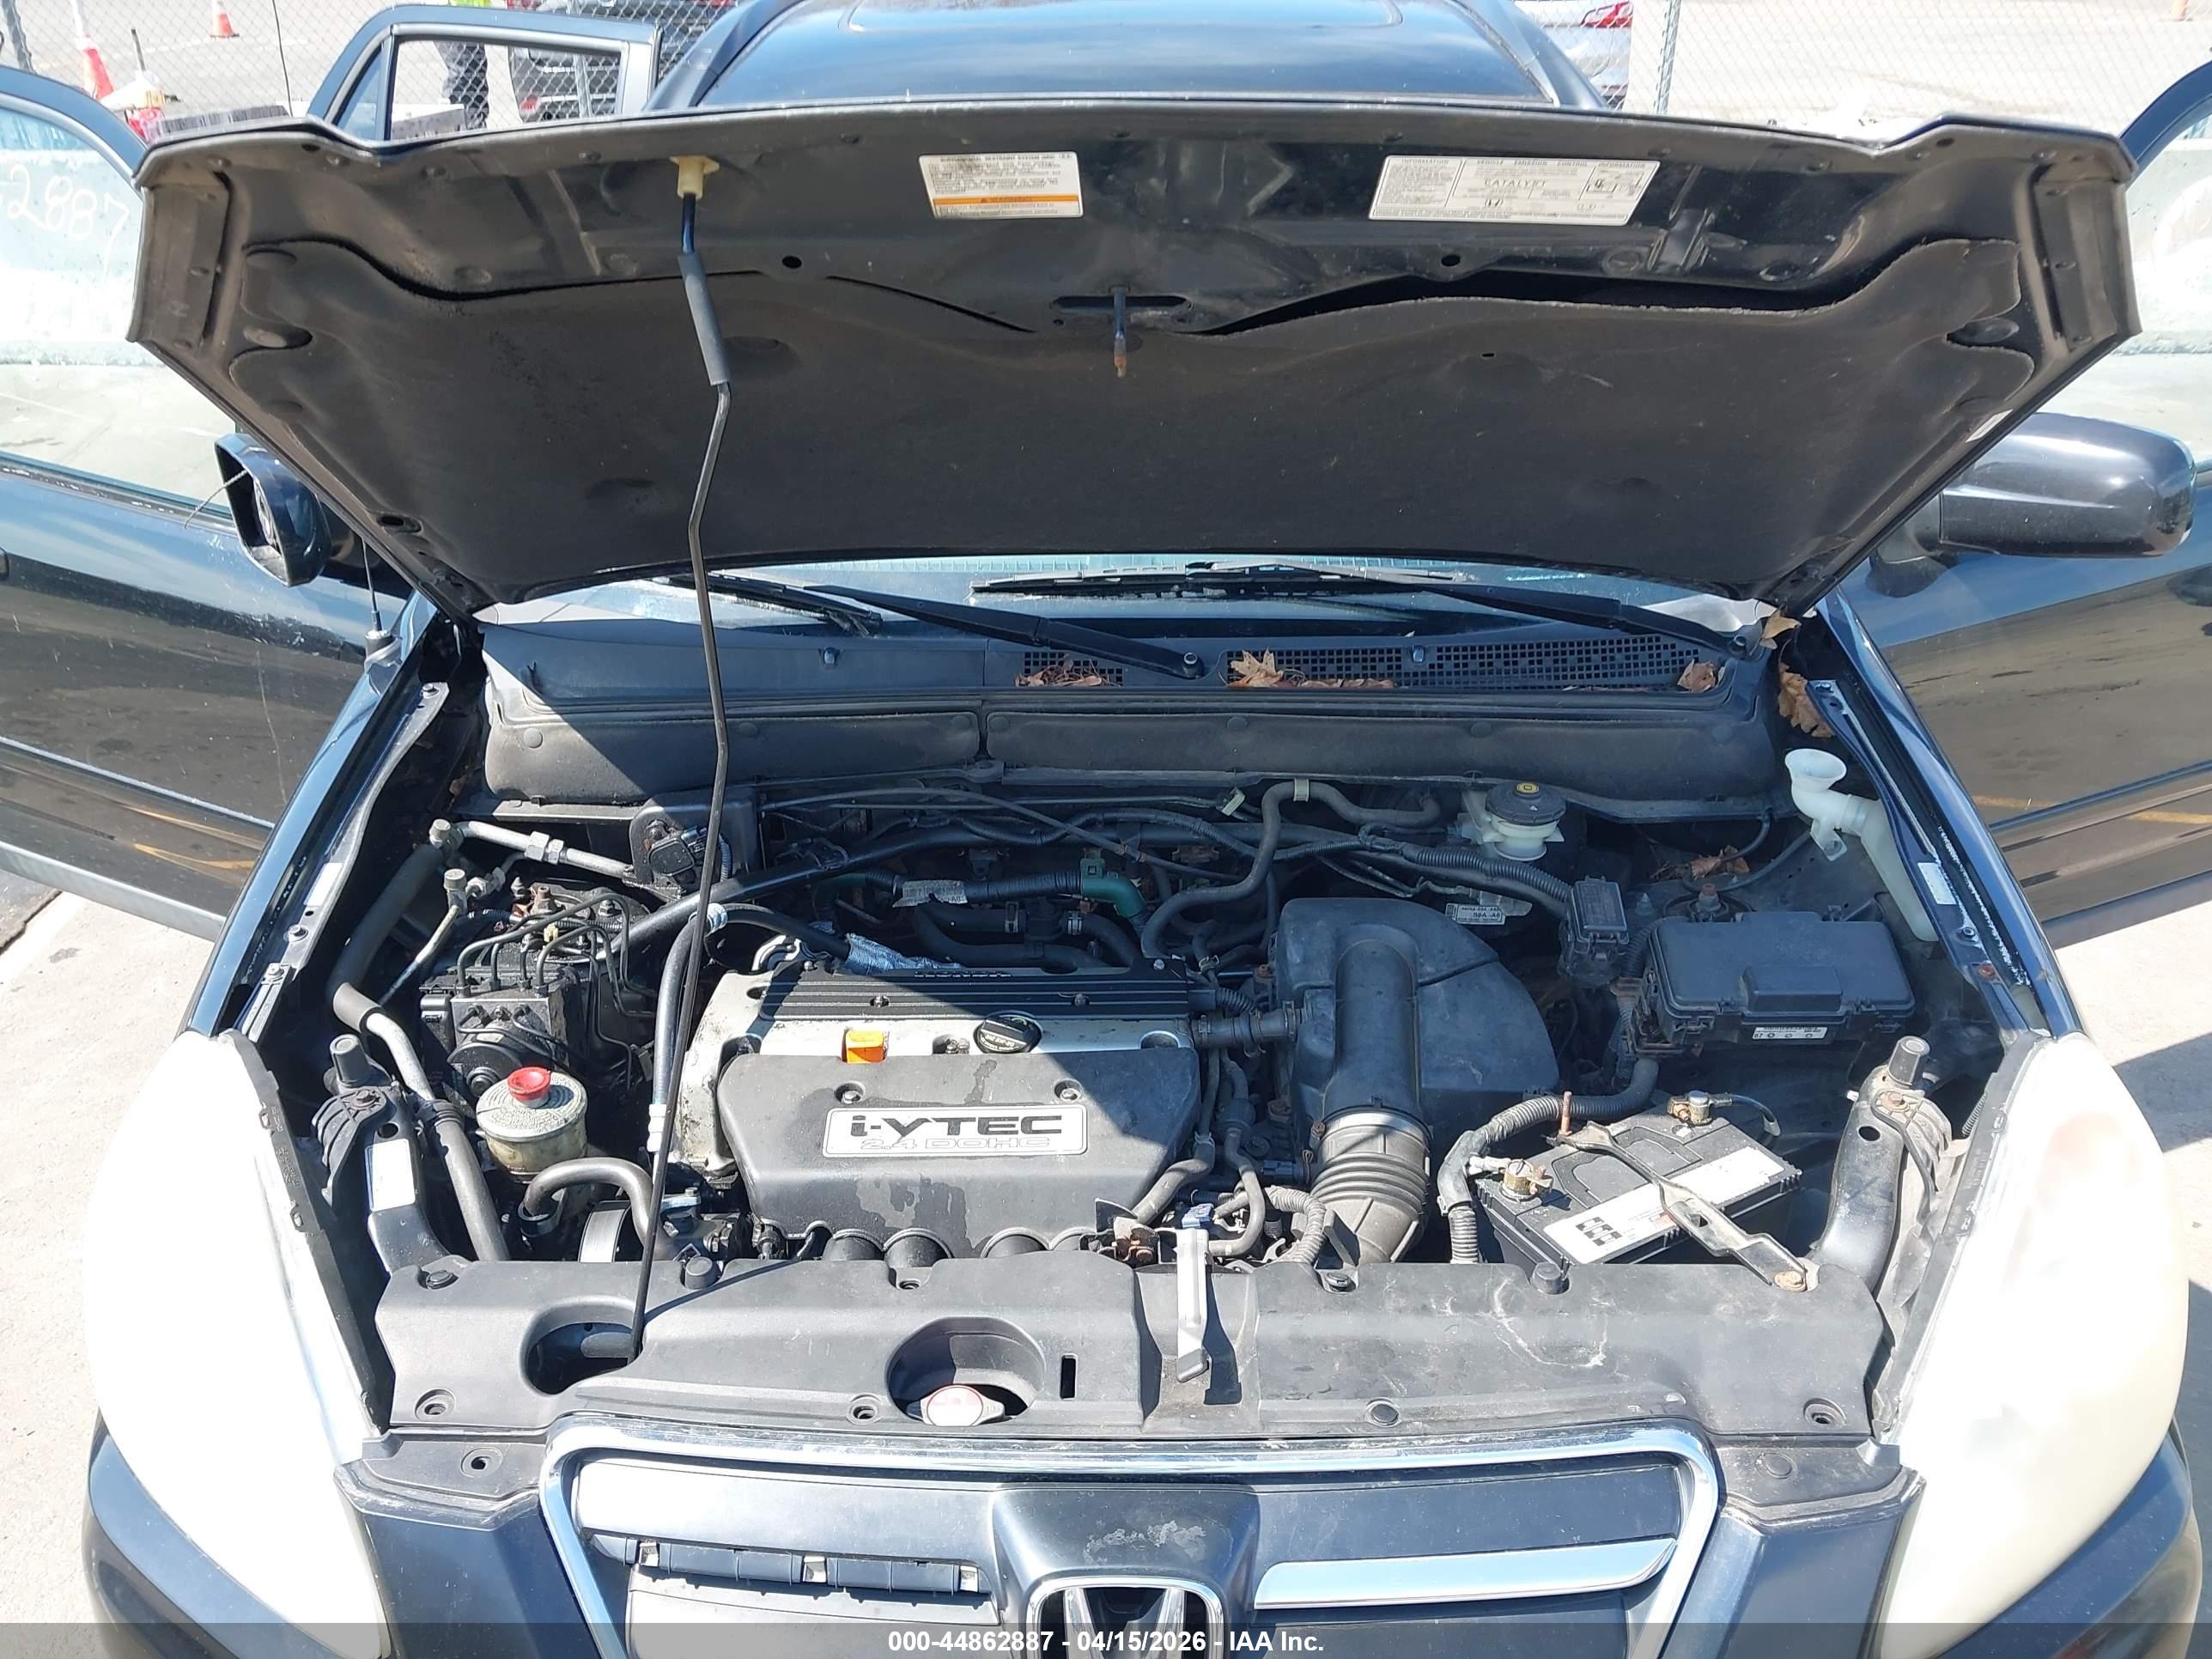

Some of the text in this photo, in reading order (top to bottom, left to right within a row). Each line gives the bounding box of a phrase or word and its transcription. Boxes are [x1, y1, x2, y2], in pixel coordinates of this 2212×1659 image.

[850, 1115, 1062, 1141] i-VTEC
[861, 1137, 1050, 1150] 2.4 DOHC
